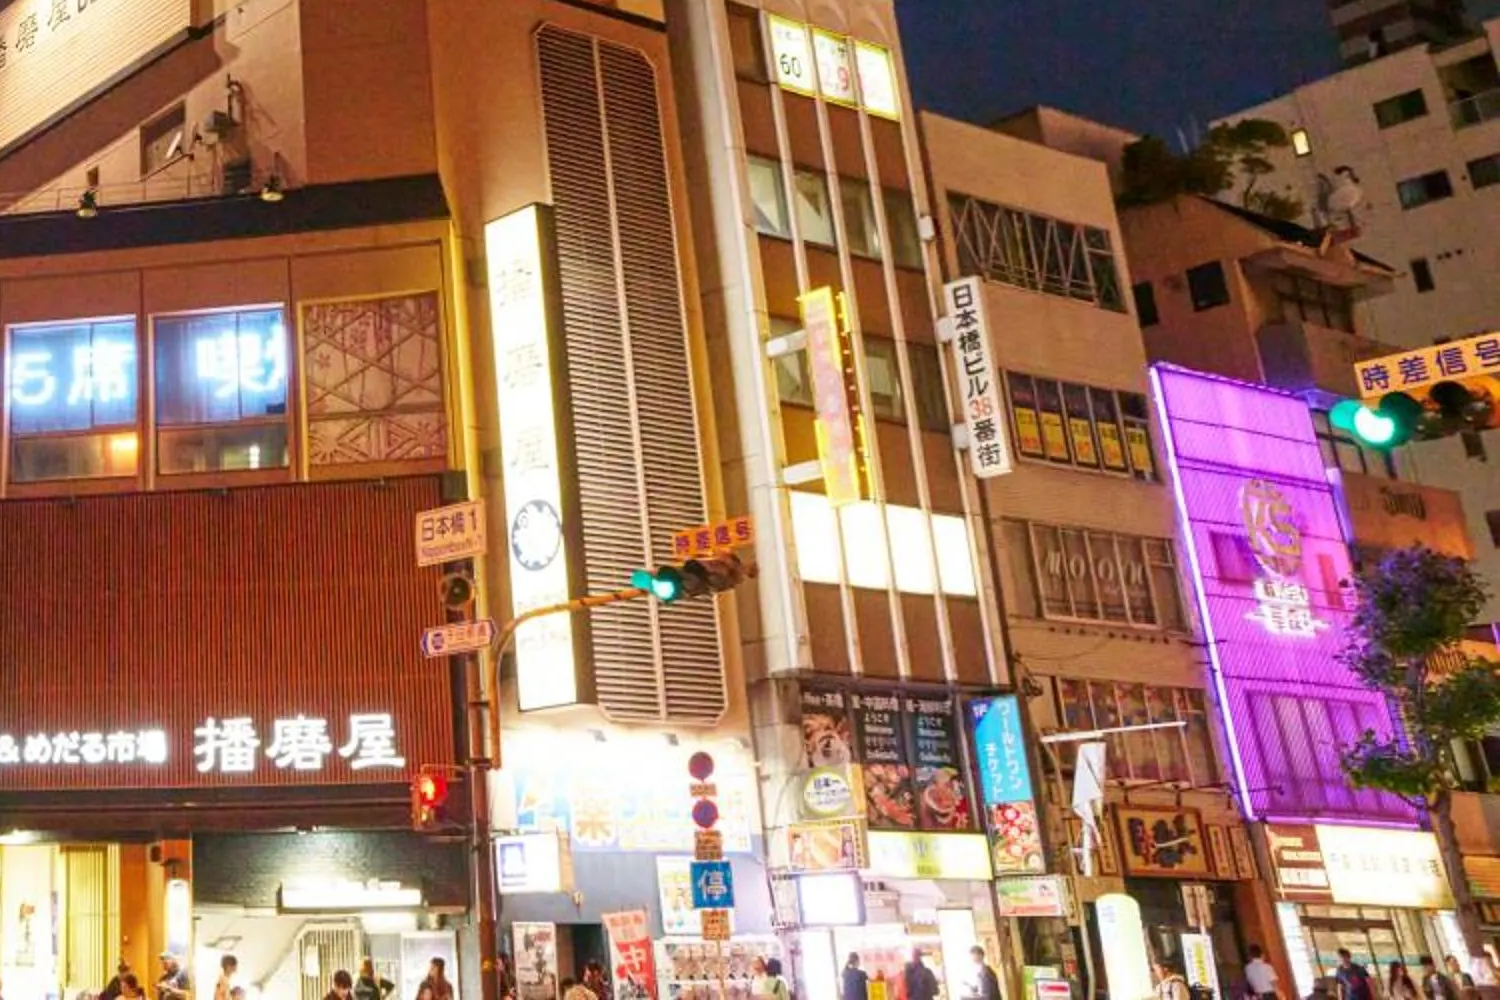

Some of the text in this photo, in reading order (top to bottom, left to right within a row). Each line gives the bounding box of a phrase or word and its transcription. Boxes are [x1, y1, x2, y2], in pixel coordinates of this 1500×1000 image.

[1362, 340, 1500, 391] 時差信号
[195, 713, 406, 773] 播磨屋
